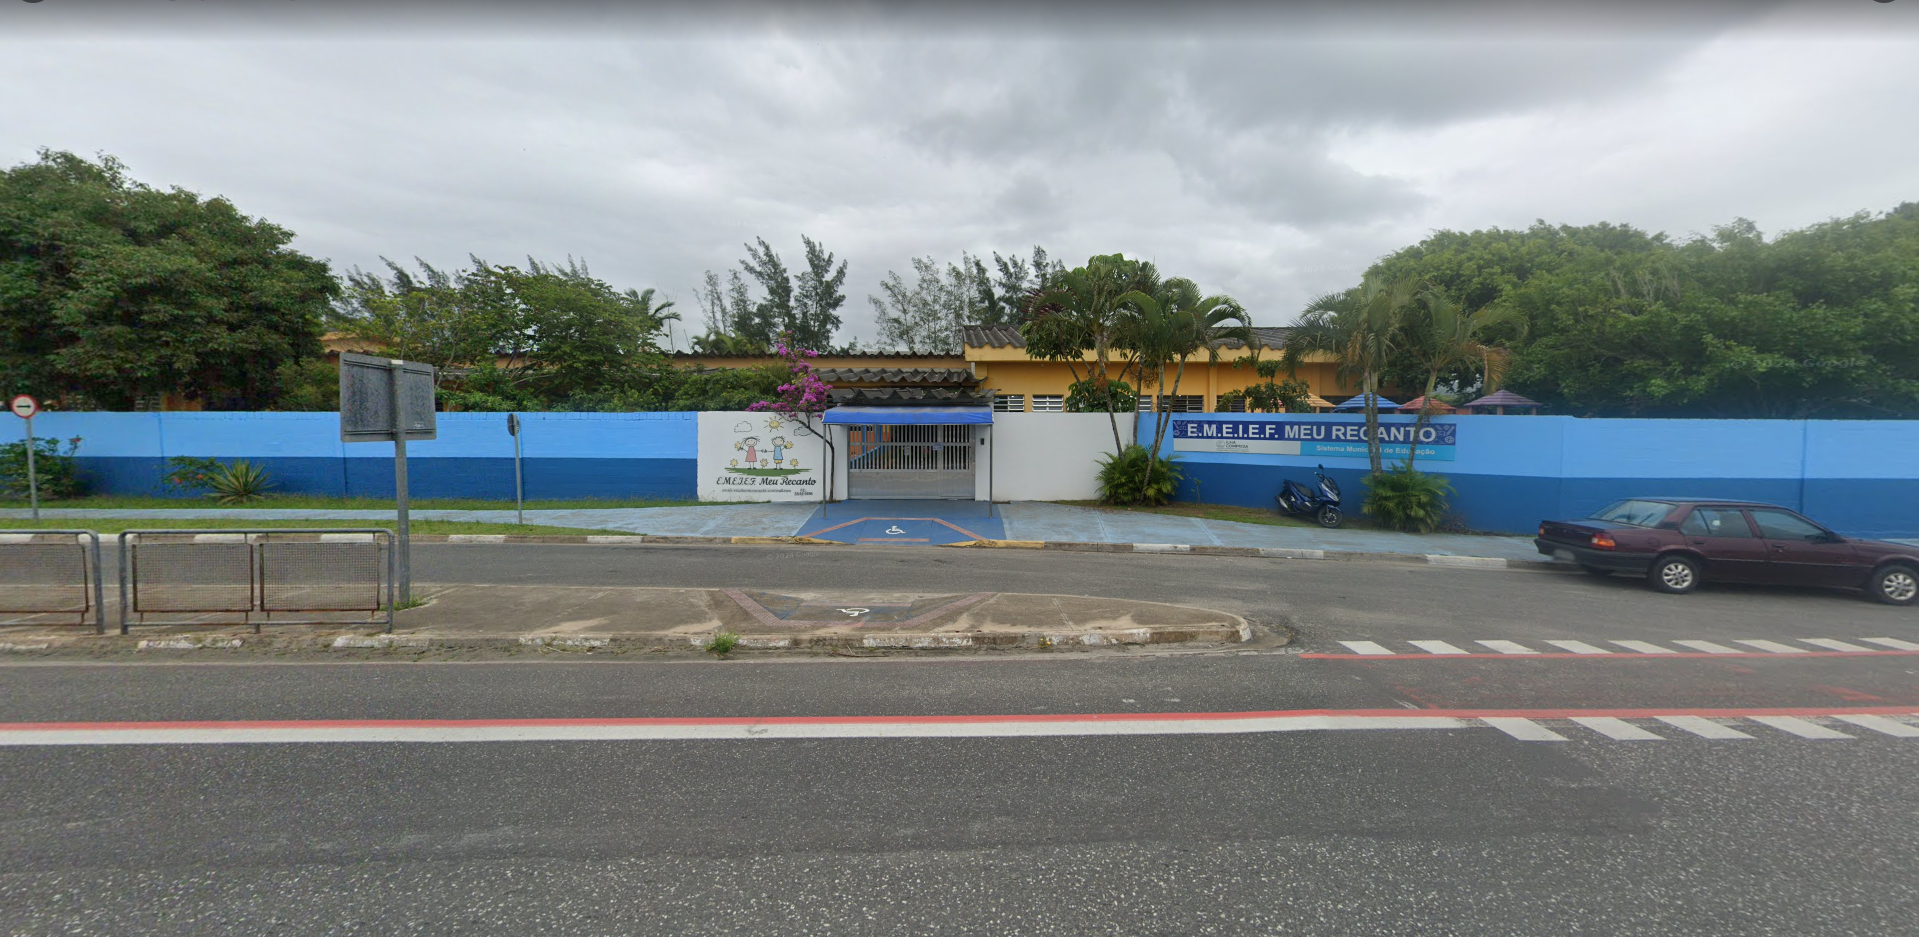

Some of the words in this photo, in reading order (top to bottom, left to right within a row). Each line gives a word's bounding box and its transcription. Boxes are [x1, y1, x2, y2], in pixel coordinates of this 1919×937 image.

[1187, 423, 1279, 438] E.M.E.I.E.F.
[1285, 425, 1325, 440] MEU
[1332, 425, 1437, 442] RECANTO
[1395, 447, 1436, 455] Eduação
[759, 477, 778, 485] Meu
[780, 477, 817, 485] Recanto
